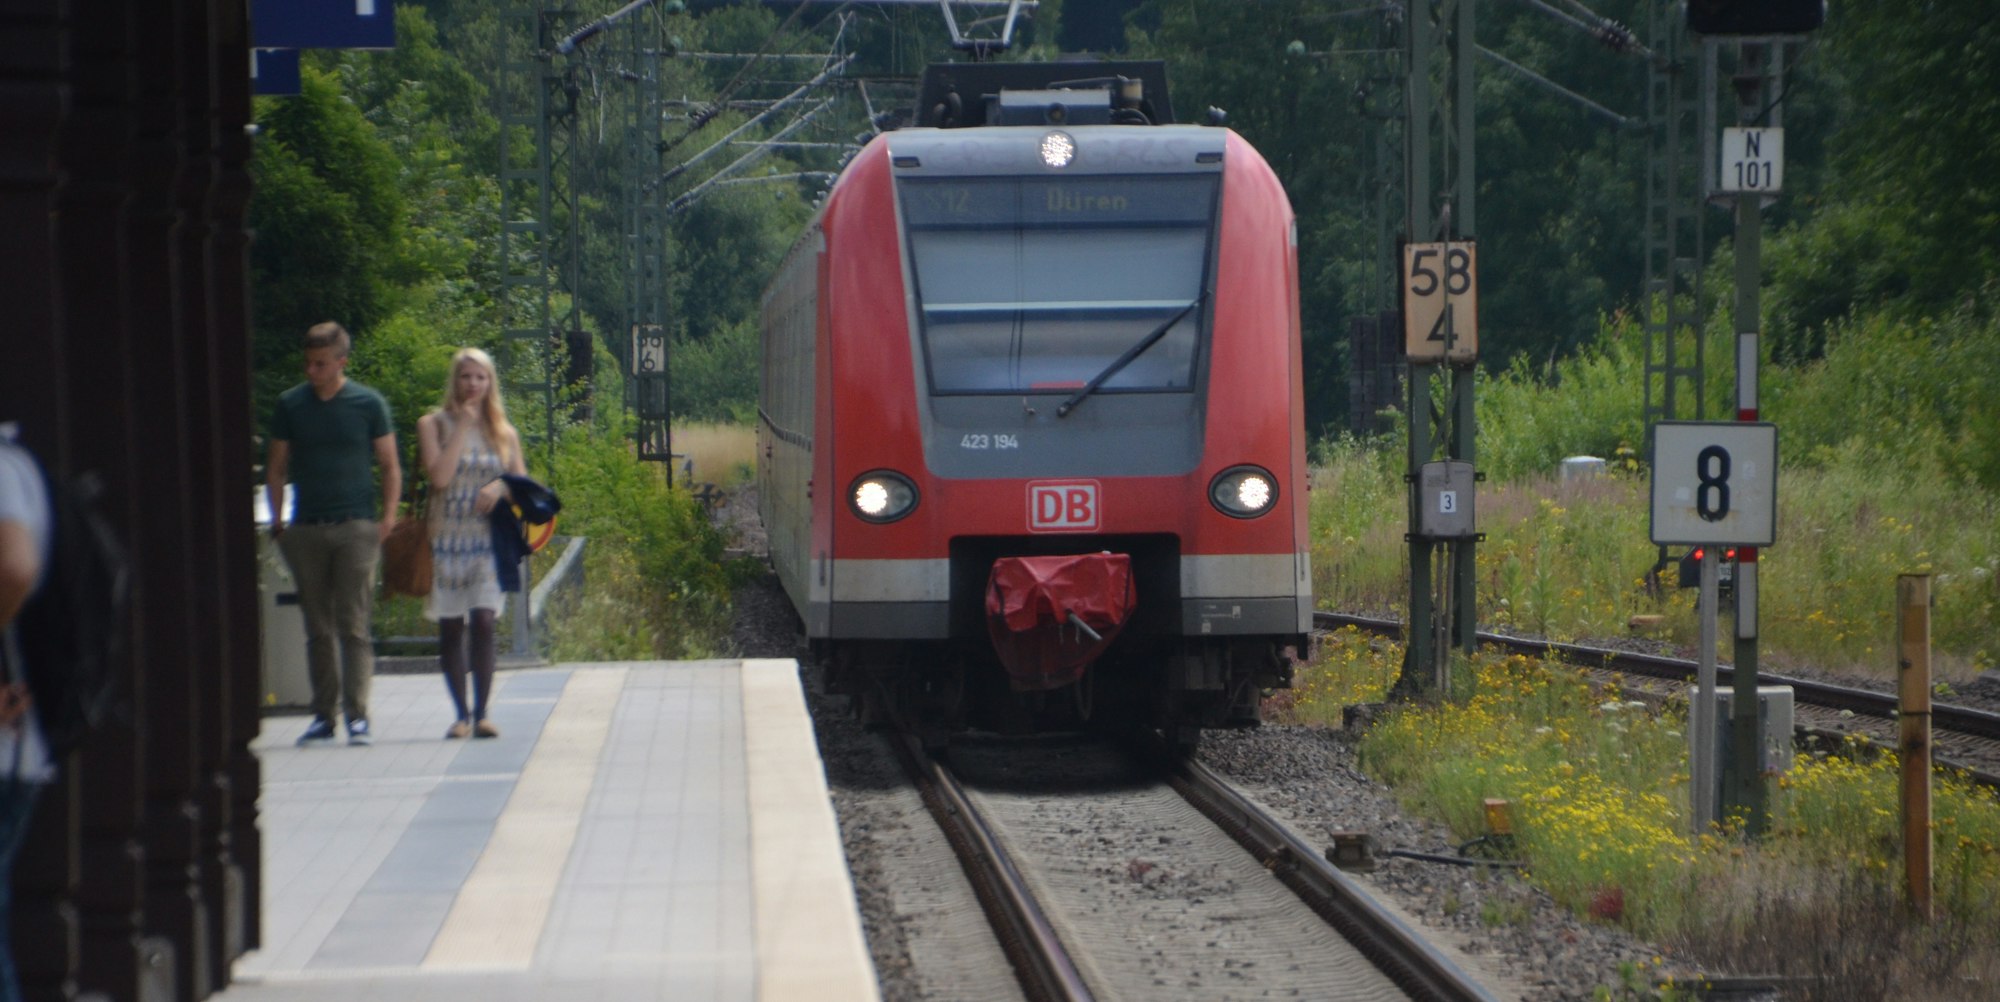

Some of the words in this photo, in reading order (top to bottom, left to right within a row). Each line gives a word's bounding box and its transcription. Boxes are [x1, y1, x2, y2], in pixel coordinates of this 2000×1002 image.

[1746, 131, 1760, 158] N
[1734, 161, 1771, 188] 101
[1047, 186, 1127, 211] Düren
[1411, 248, 1471, 296] 58
[1426, 303, 1458, 350] 4
[643, 351, 655, 370] 6
[960, 434, 989, 449] 423
[993, 434, 1018, 449] 194
[1697, 444, 1731, 522] 8
[1037, 489, 1092, 523] DB
[1444, 494, 1452, 510] 3
